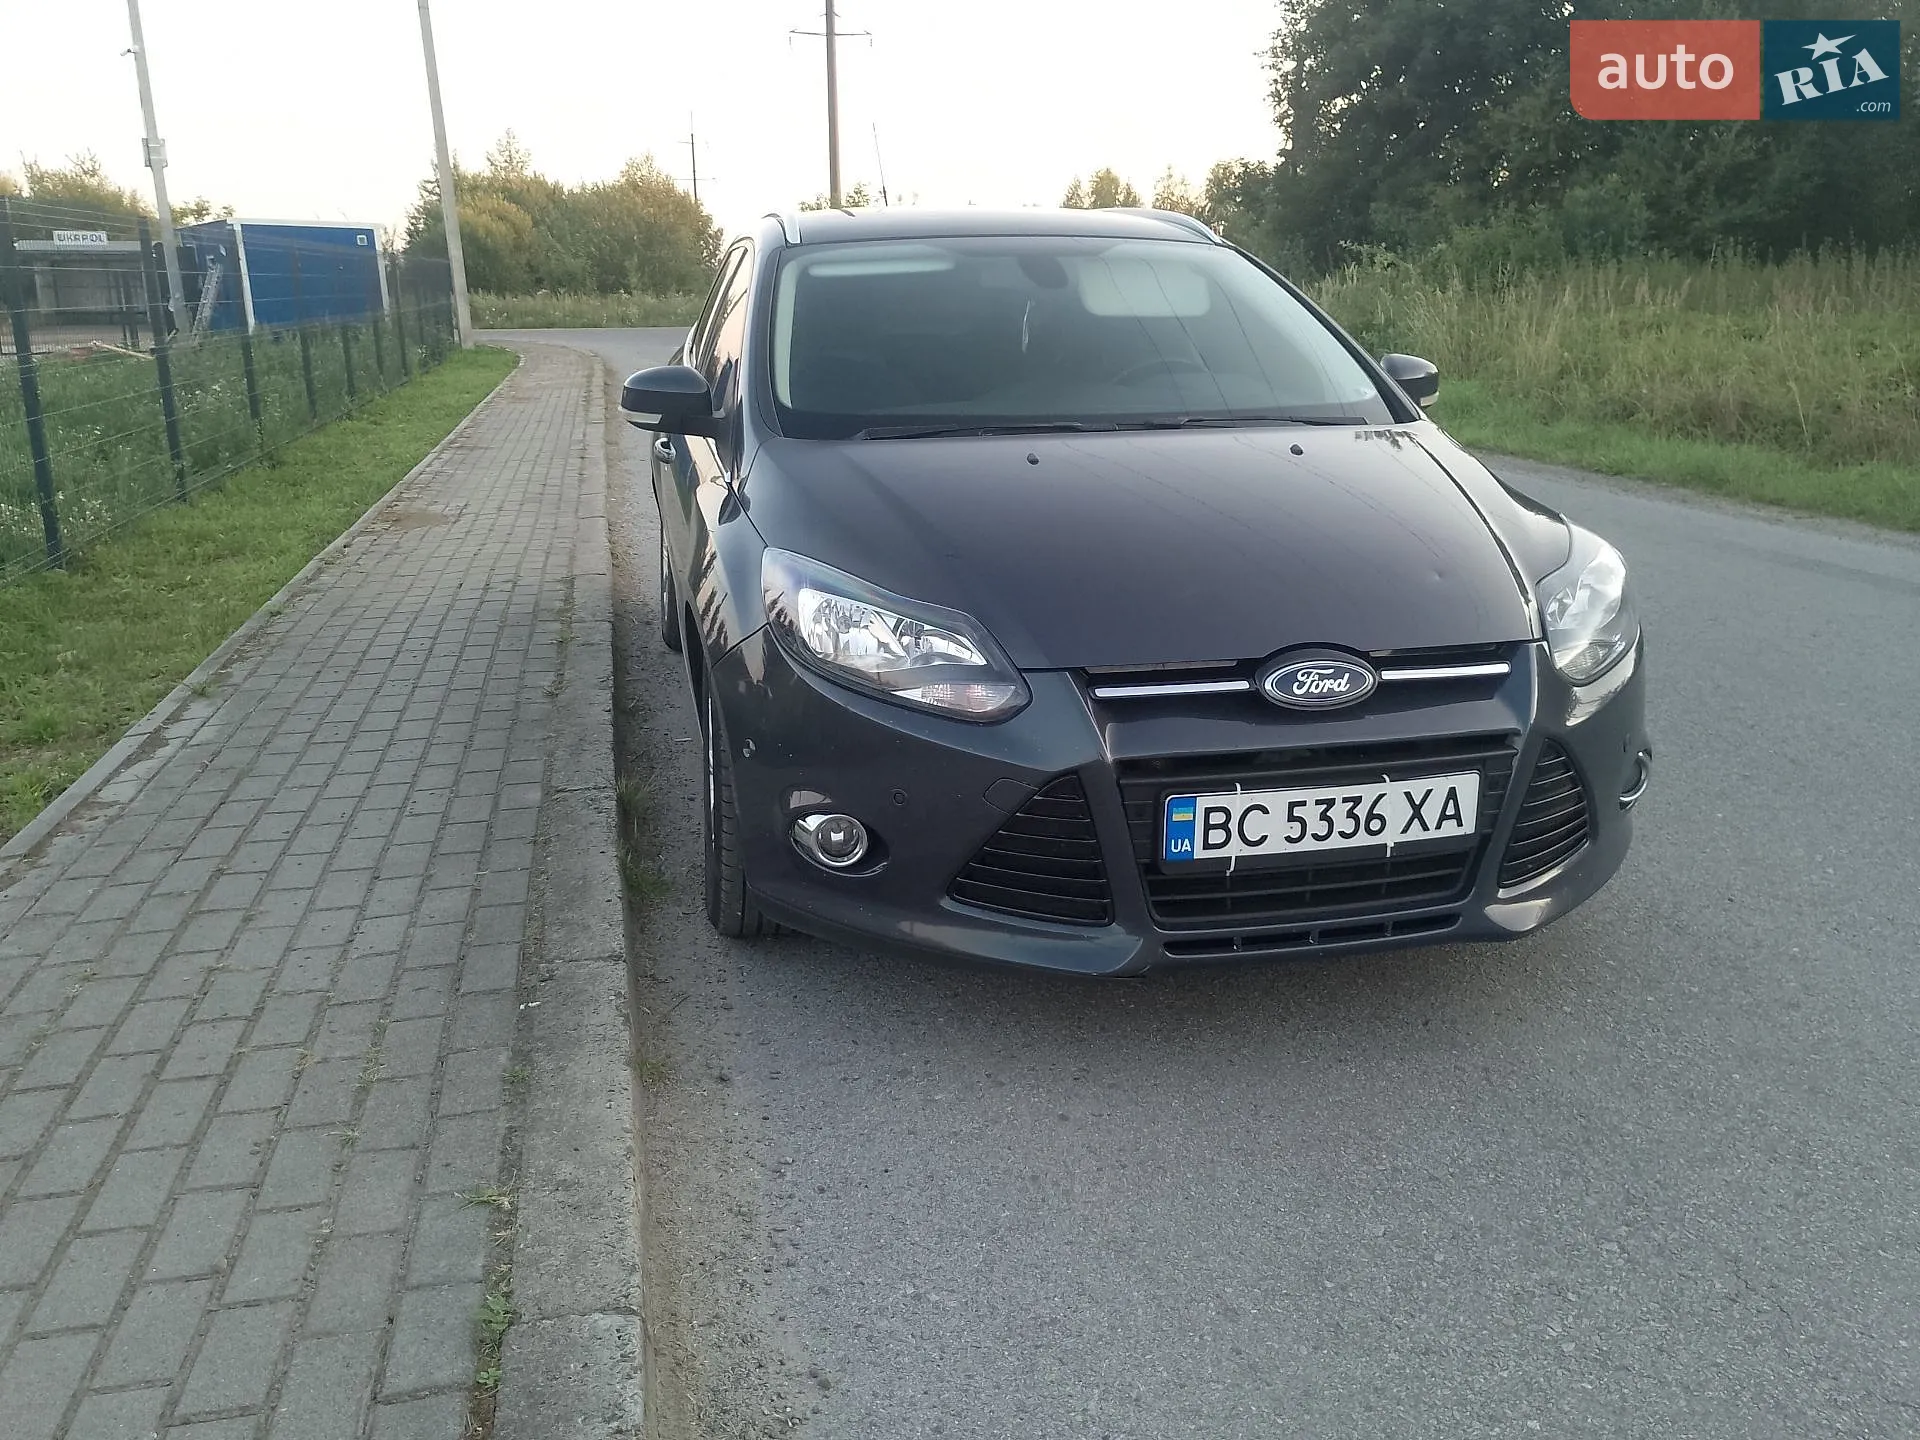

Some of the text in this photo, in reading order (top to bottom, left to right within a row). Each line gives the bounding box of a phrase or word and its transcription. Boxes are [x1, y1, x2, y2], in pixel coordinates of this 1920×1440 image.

[1292, 667, 1351, 695] Ford
[1201, 786, 1464, 851] BC 5336 XA
[1170, 837, 1192, 853] UA
